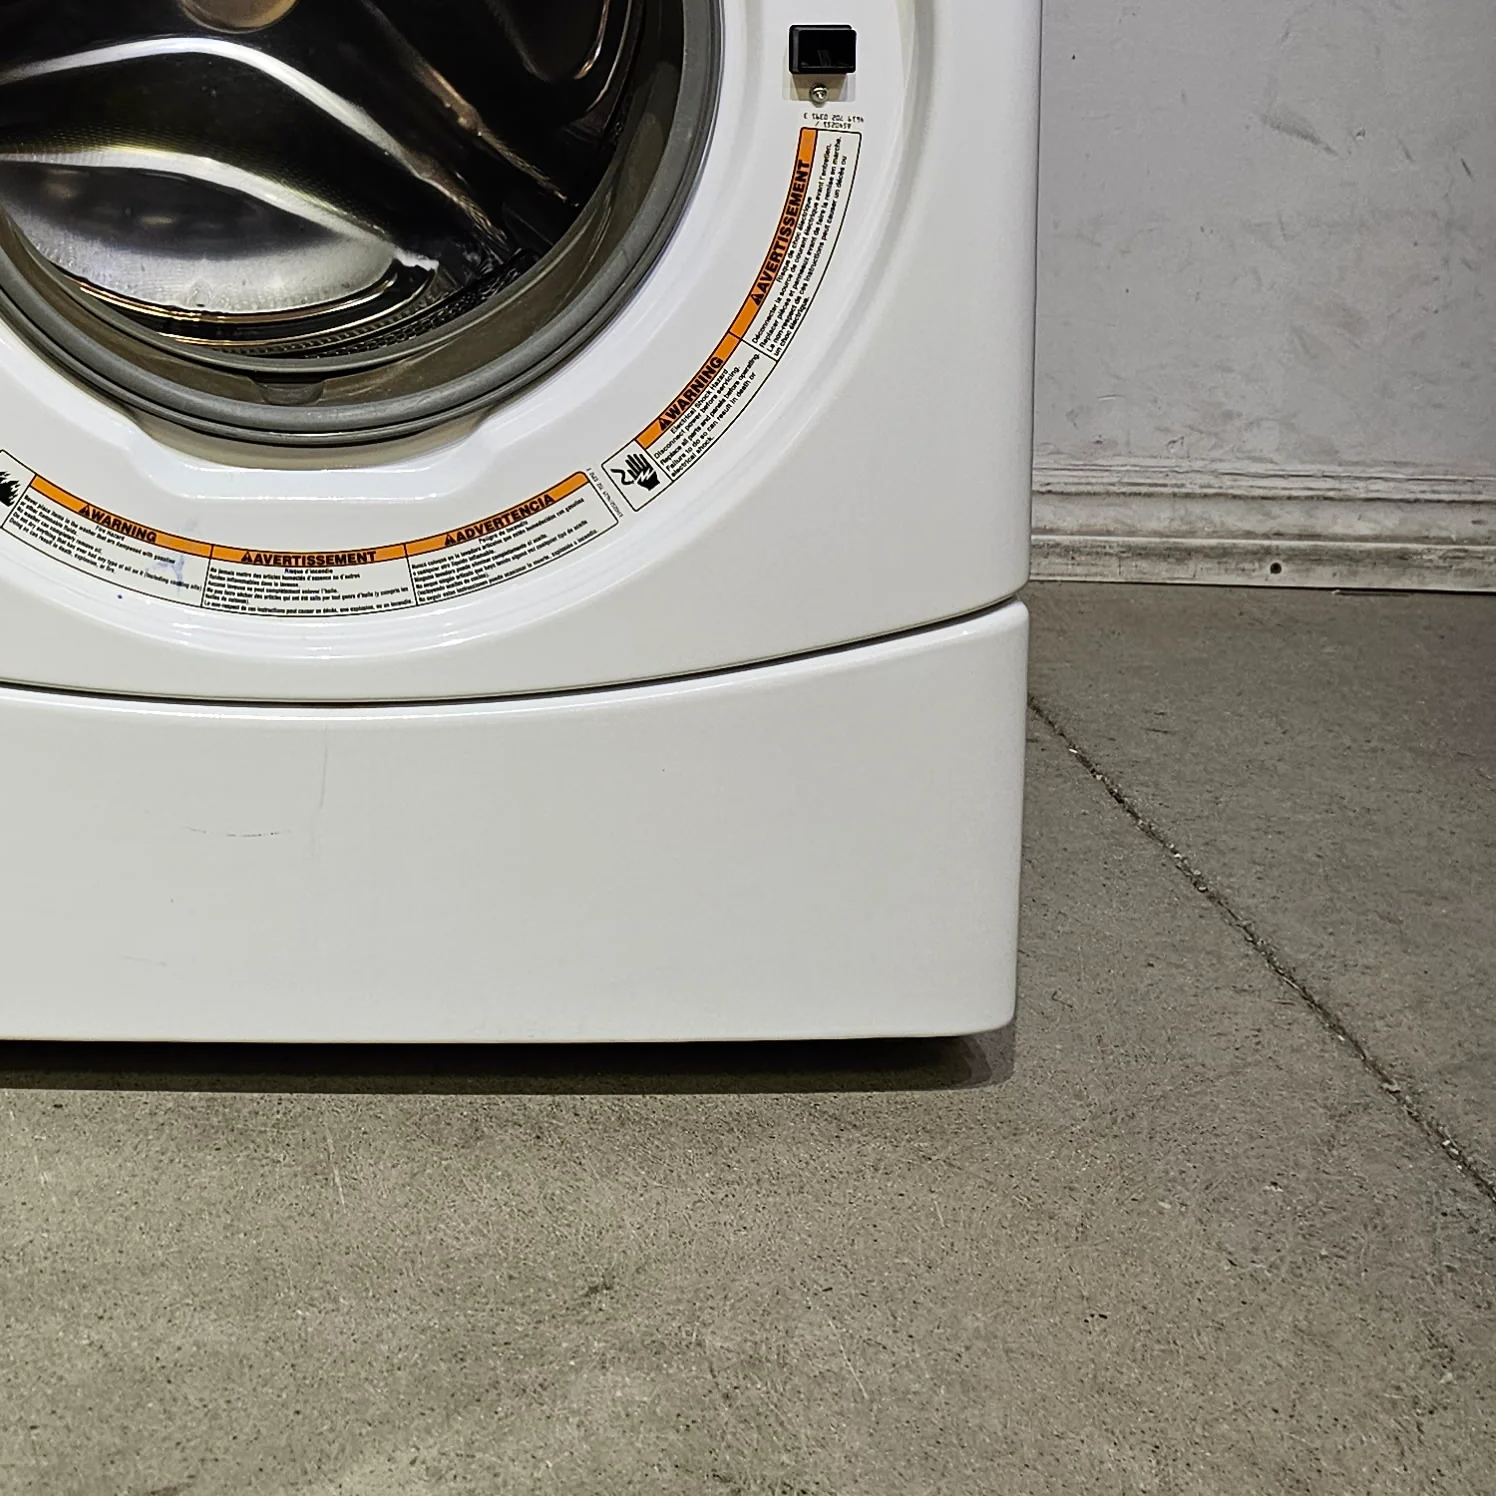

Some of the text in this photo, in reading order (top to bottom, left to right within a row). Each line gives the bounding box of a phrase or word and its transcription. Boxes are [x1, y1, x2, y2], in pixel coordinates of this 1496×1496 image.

[759, 160, 810, 292] AVERTISSEMENT
[666, 357, 723, 421] WARNING
[670, 369, 728, 434] Electrical Shock Hazard
[91, 512, 156, 542] WARNING
[455, 494, 554, 544] ADVERTENCIA
[253, 552, 376, 565] AVERTISSEMENT
